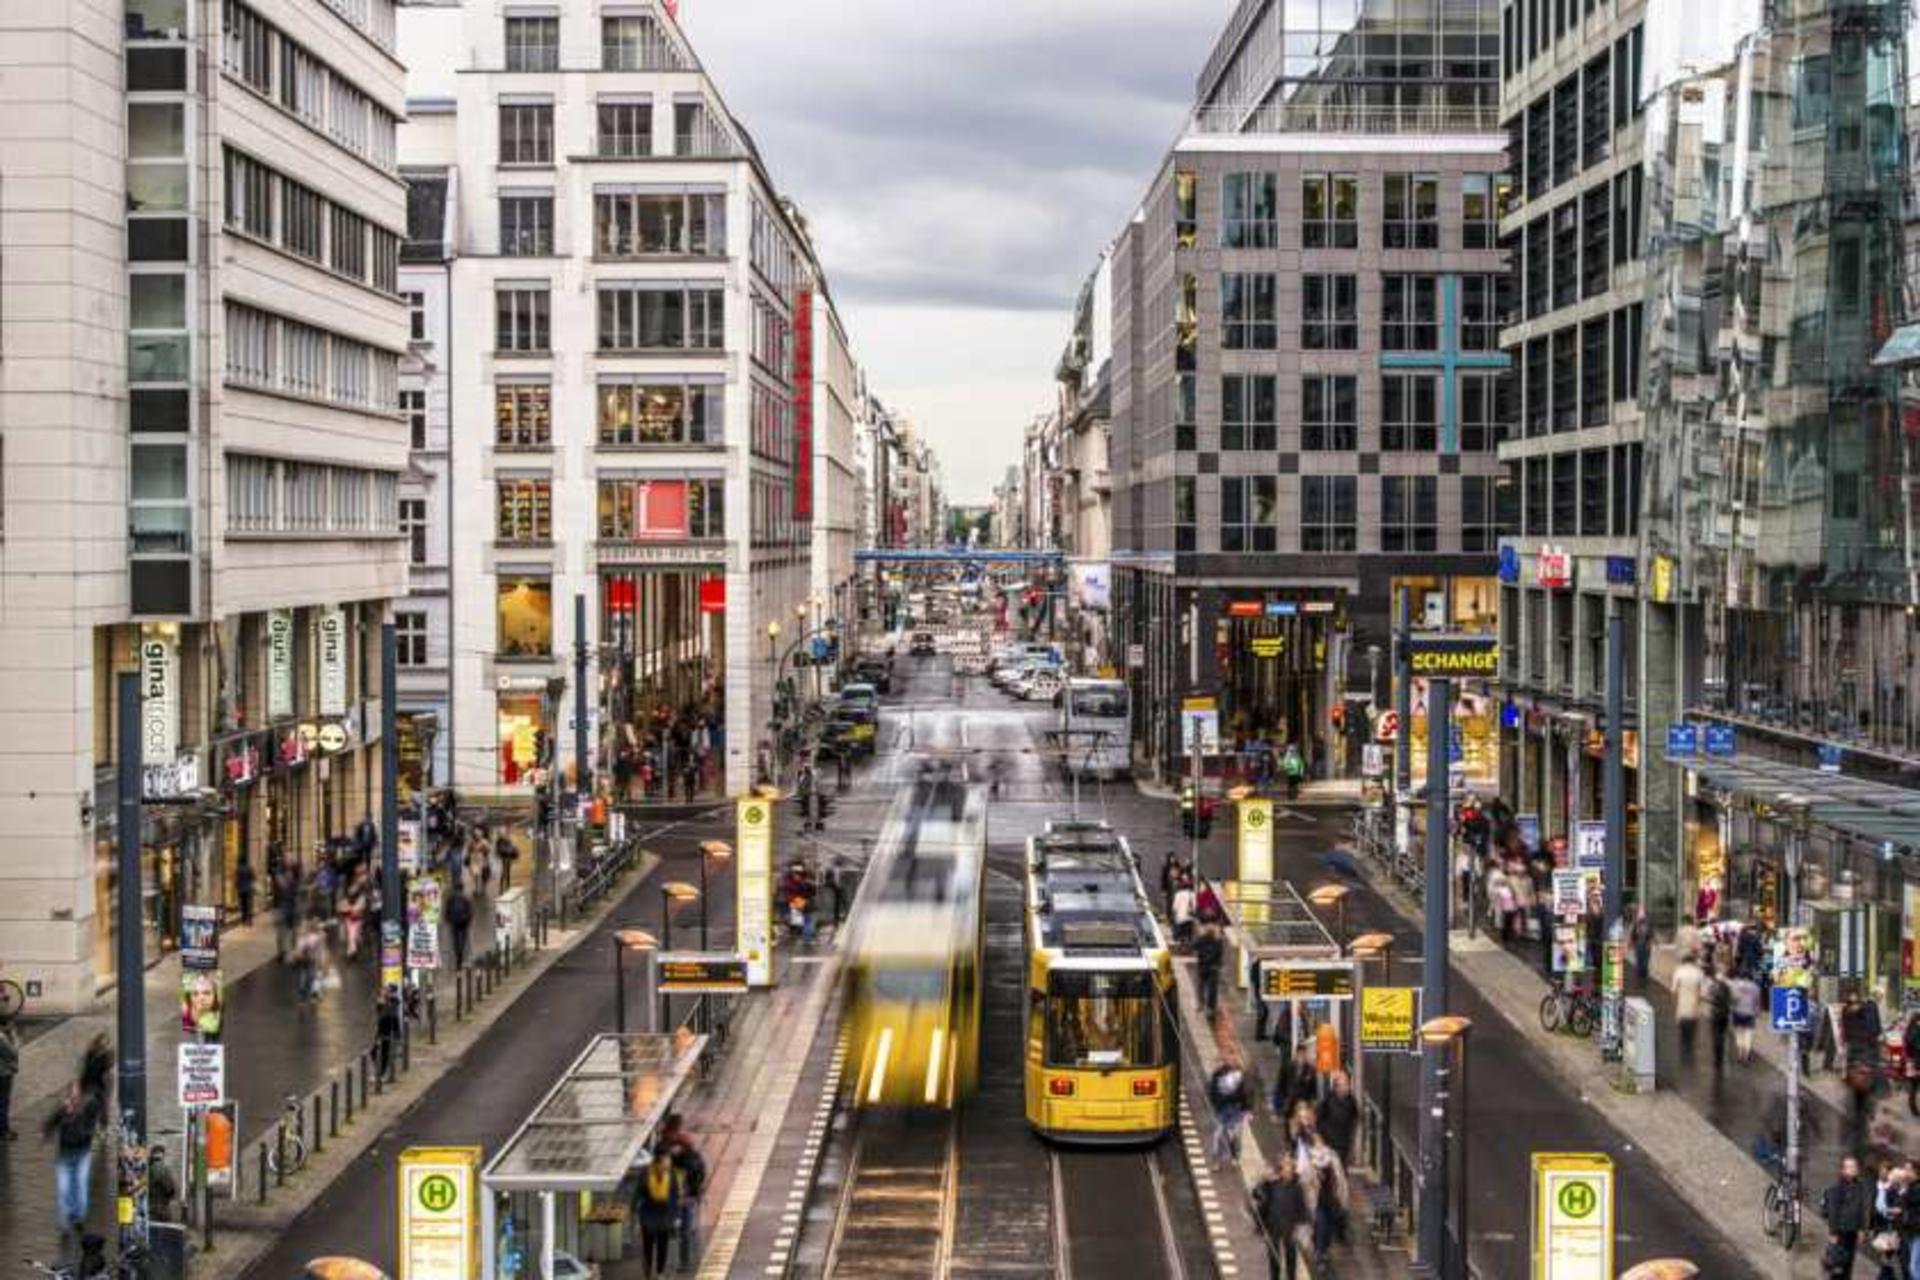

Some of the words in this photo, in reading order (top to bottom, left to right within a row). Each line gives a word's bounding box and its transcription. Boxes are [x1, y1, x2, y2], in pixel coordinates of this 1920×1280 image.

[145, 642, 170, 698] gina
[1787, 997, 1801, 1019] P
[428, 1183, 447, 1204] H
[1567, 1188, 1587, 1210] H
